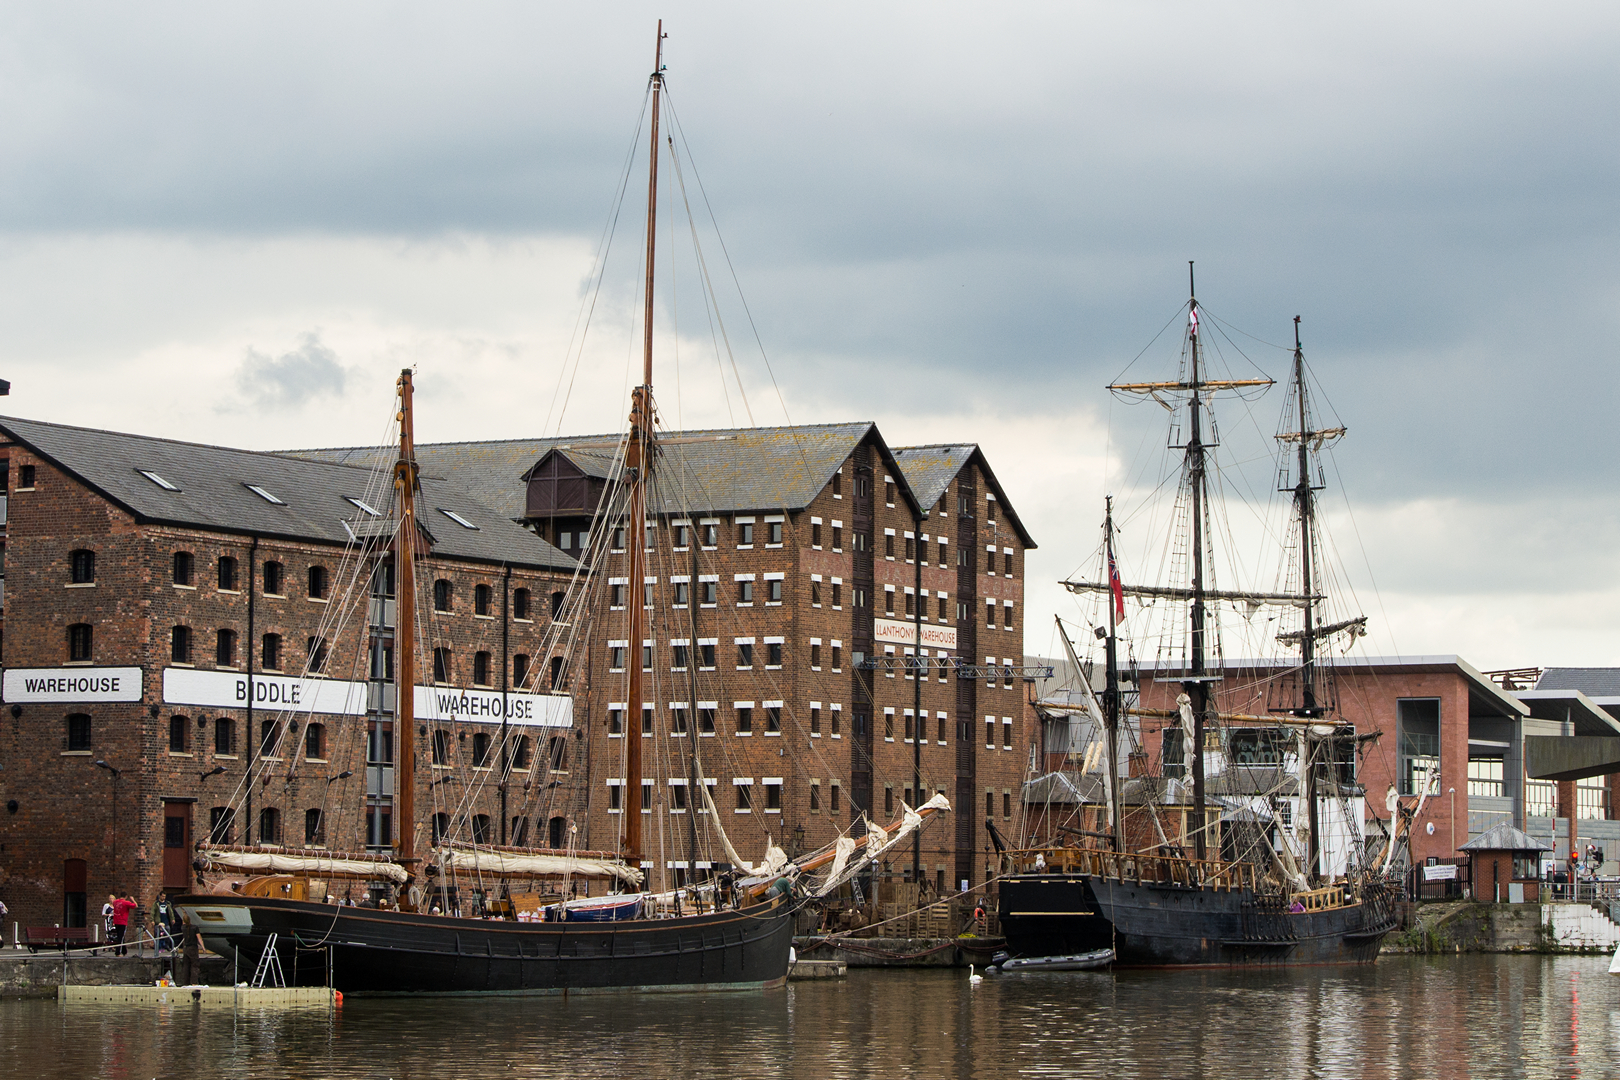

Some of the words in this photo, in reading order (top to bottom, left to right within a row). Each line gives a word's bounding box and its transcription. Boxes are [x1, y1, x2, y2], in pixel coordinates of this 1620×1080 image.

[876, 624, 915, 638] LLANTHONY
[25, 678, 120, 693] WAREHOUSE
[236, 680, 300, 704] BIDDLE
[438, 694, 533, 719] WAREHOUSE
